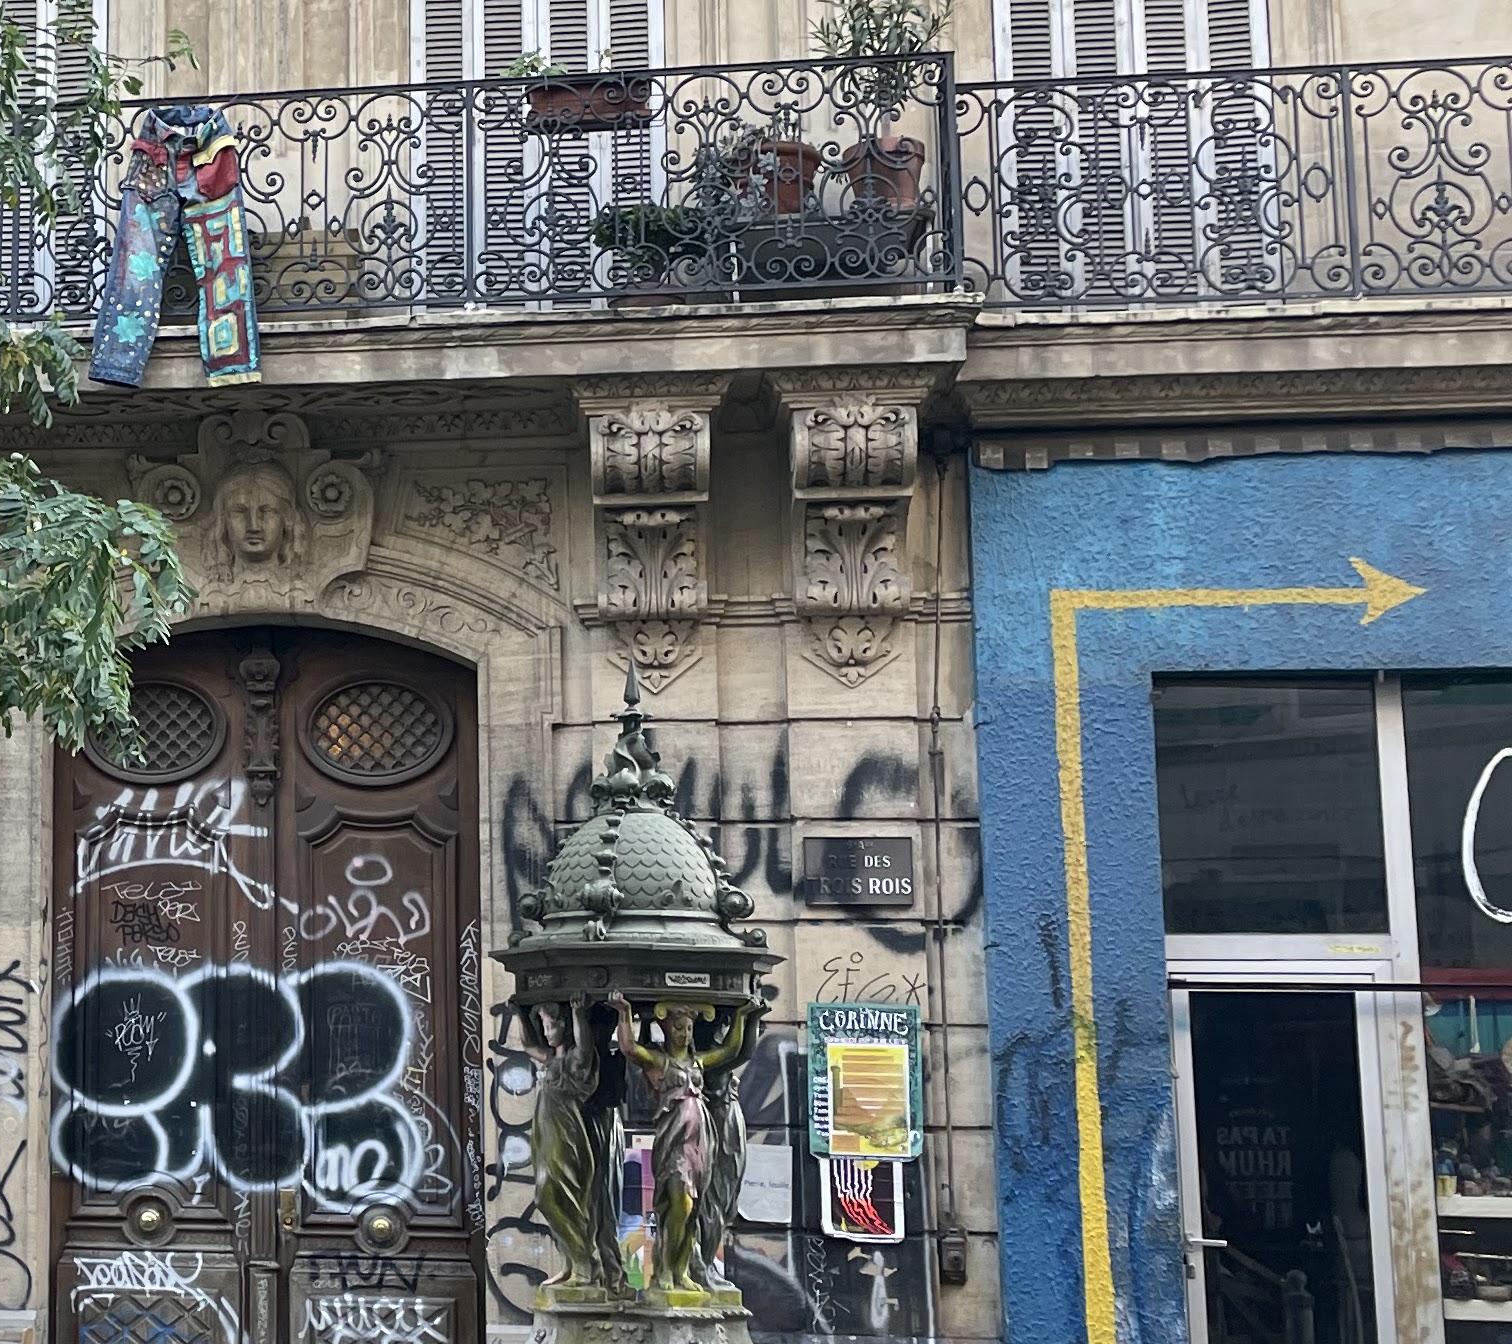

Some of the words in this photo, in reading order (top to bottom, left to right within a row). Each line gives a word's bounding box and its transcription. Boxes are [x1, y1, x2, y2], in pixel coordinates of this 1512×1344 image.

[827, 854, 857, 868] RE
[864, 855, 891, 868] DES
[868, 877, 912, 895] ROIS
